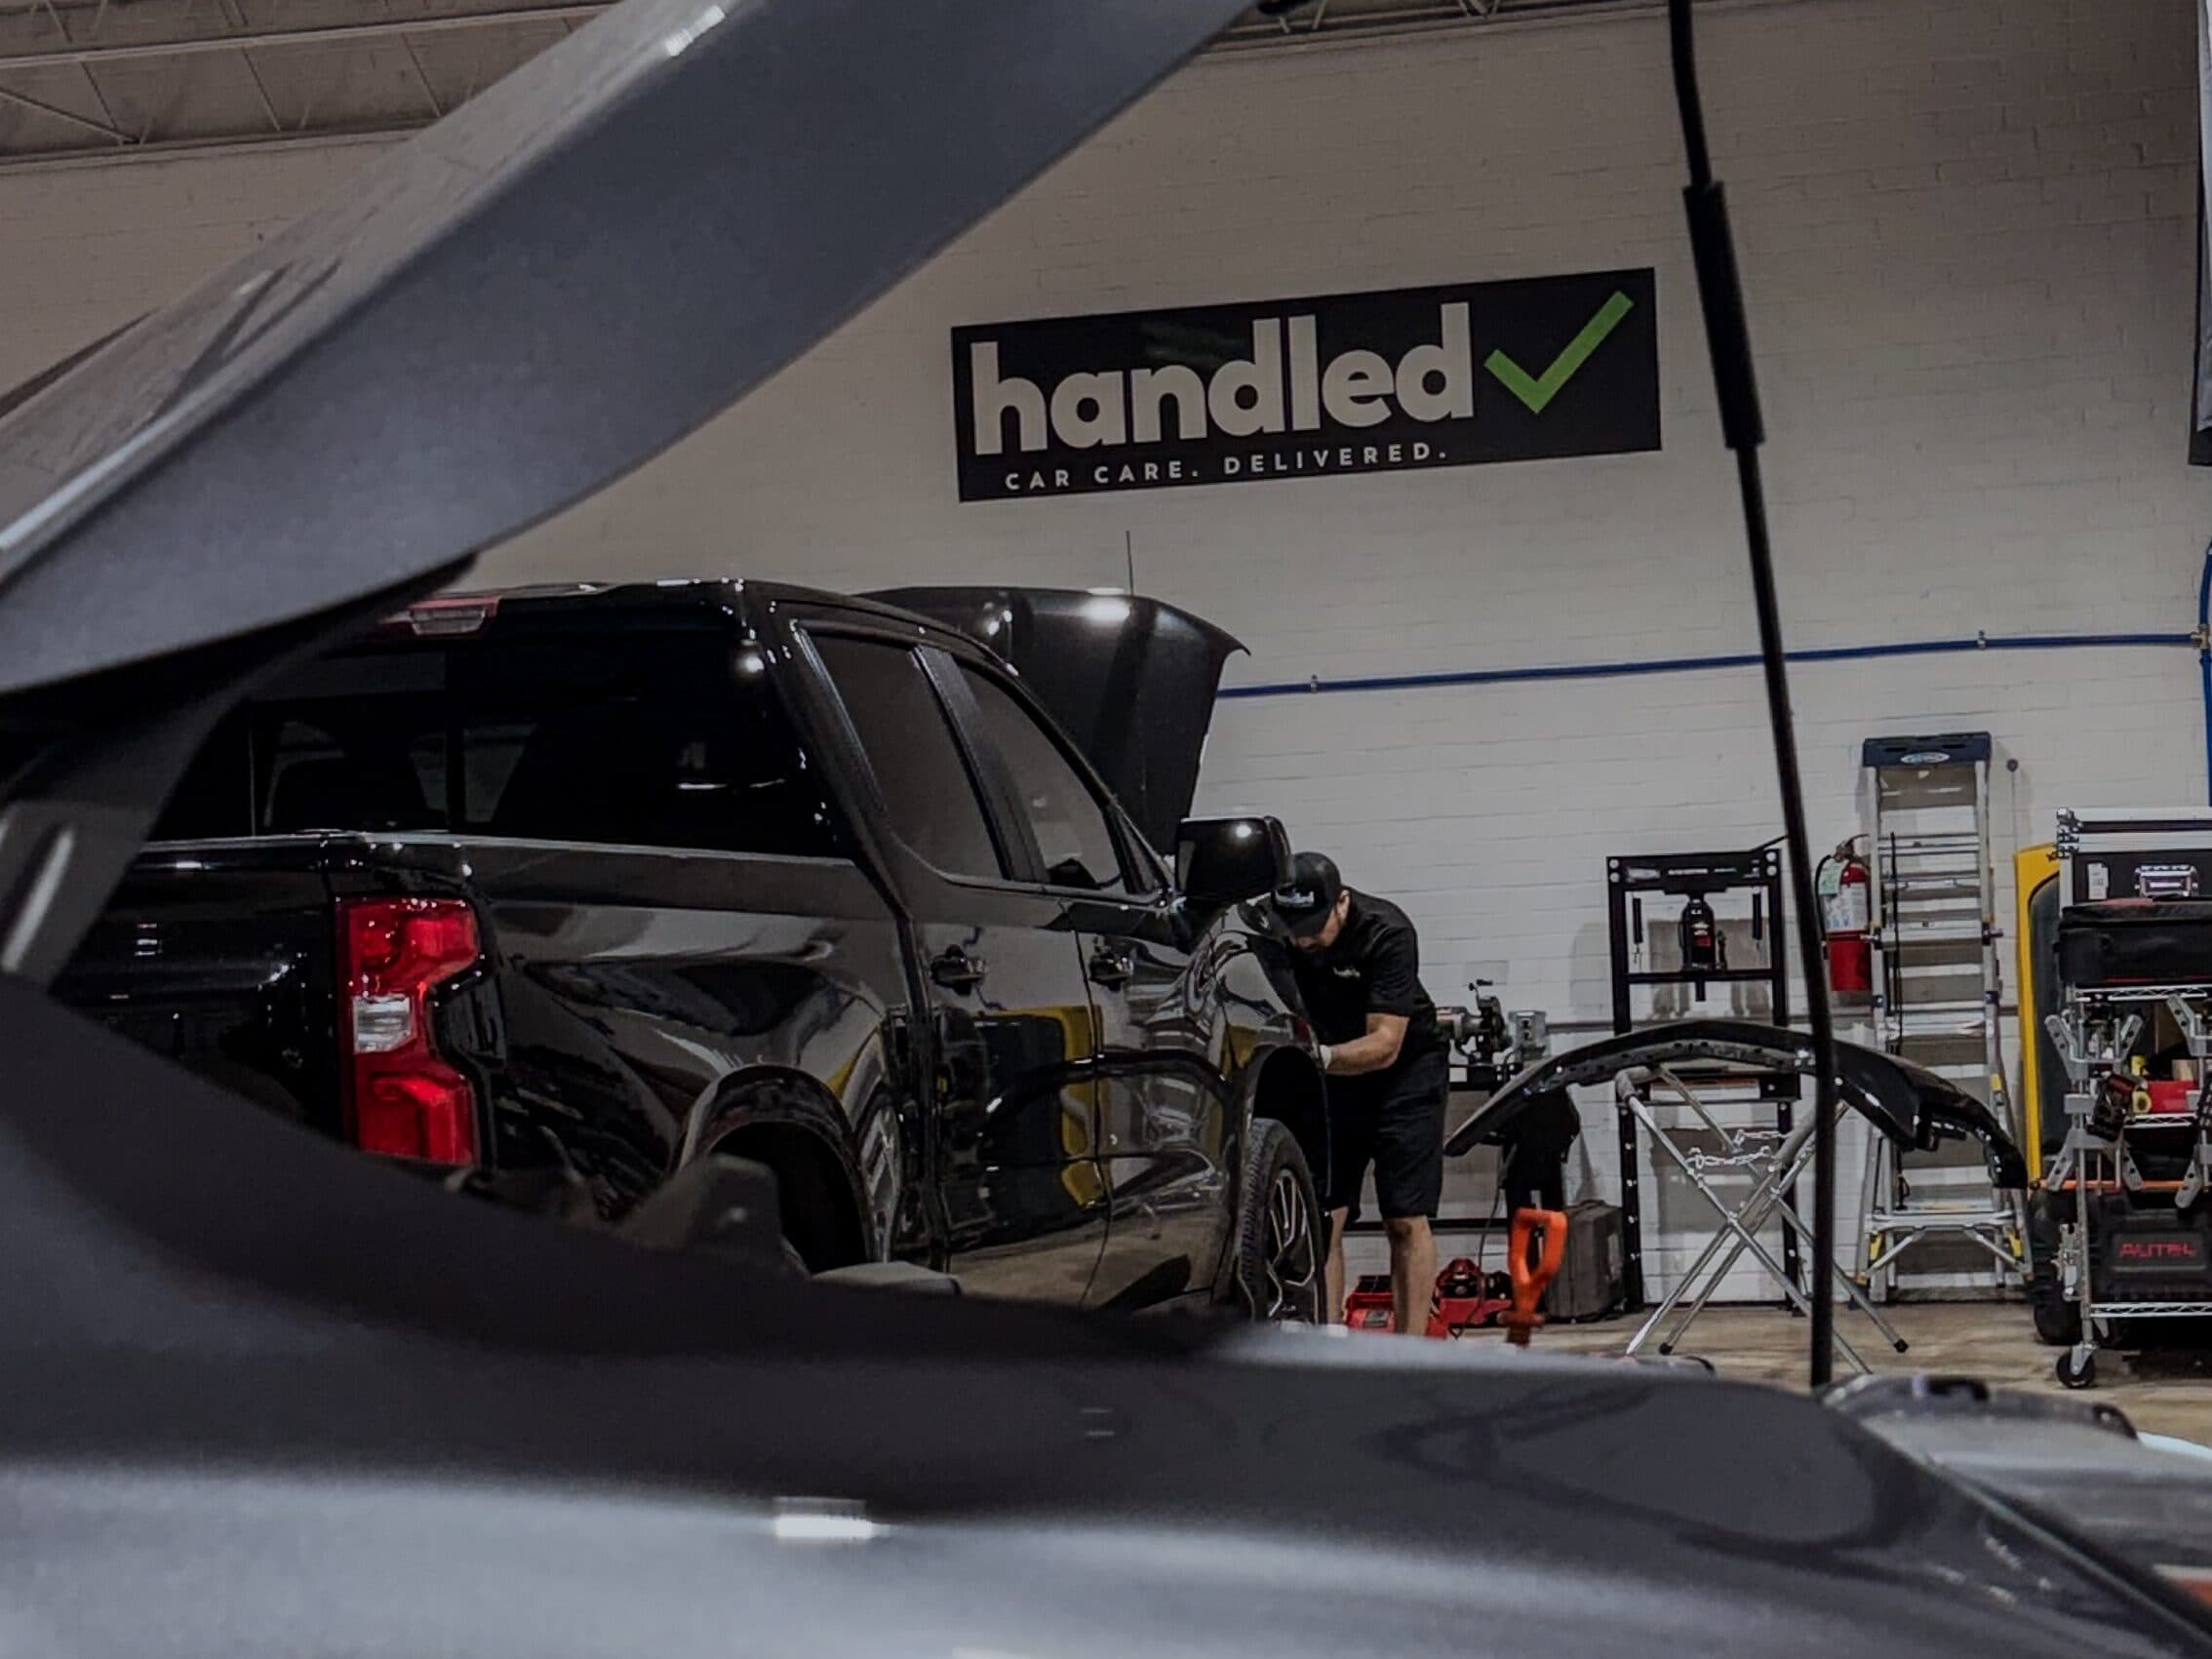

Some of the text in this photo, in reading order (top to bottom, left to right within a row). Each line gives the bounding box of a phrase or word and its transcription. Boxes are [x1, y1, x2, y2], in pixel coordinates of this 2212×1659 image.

[971, 302, 1474, 455] handled
[1006, 442, 1447, 491] CAR CARE. DELIVERED.
